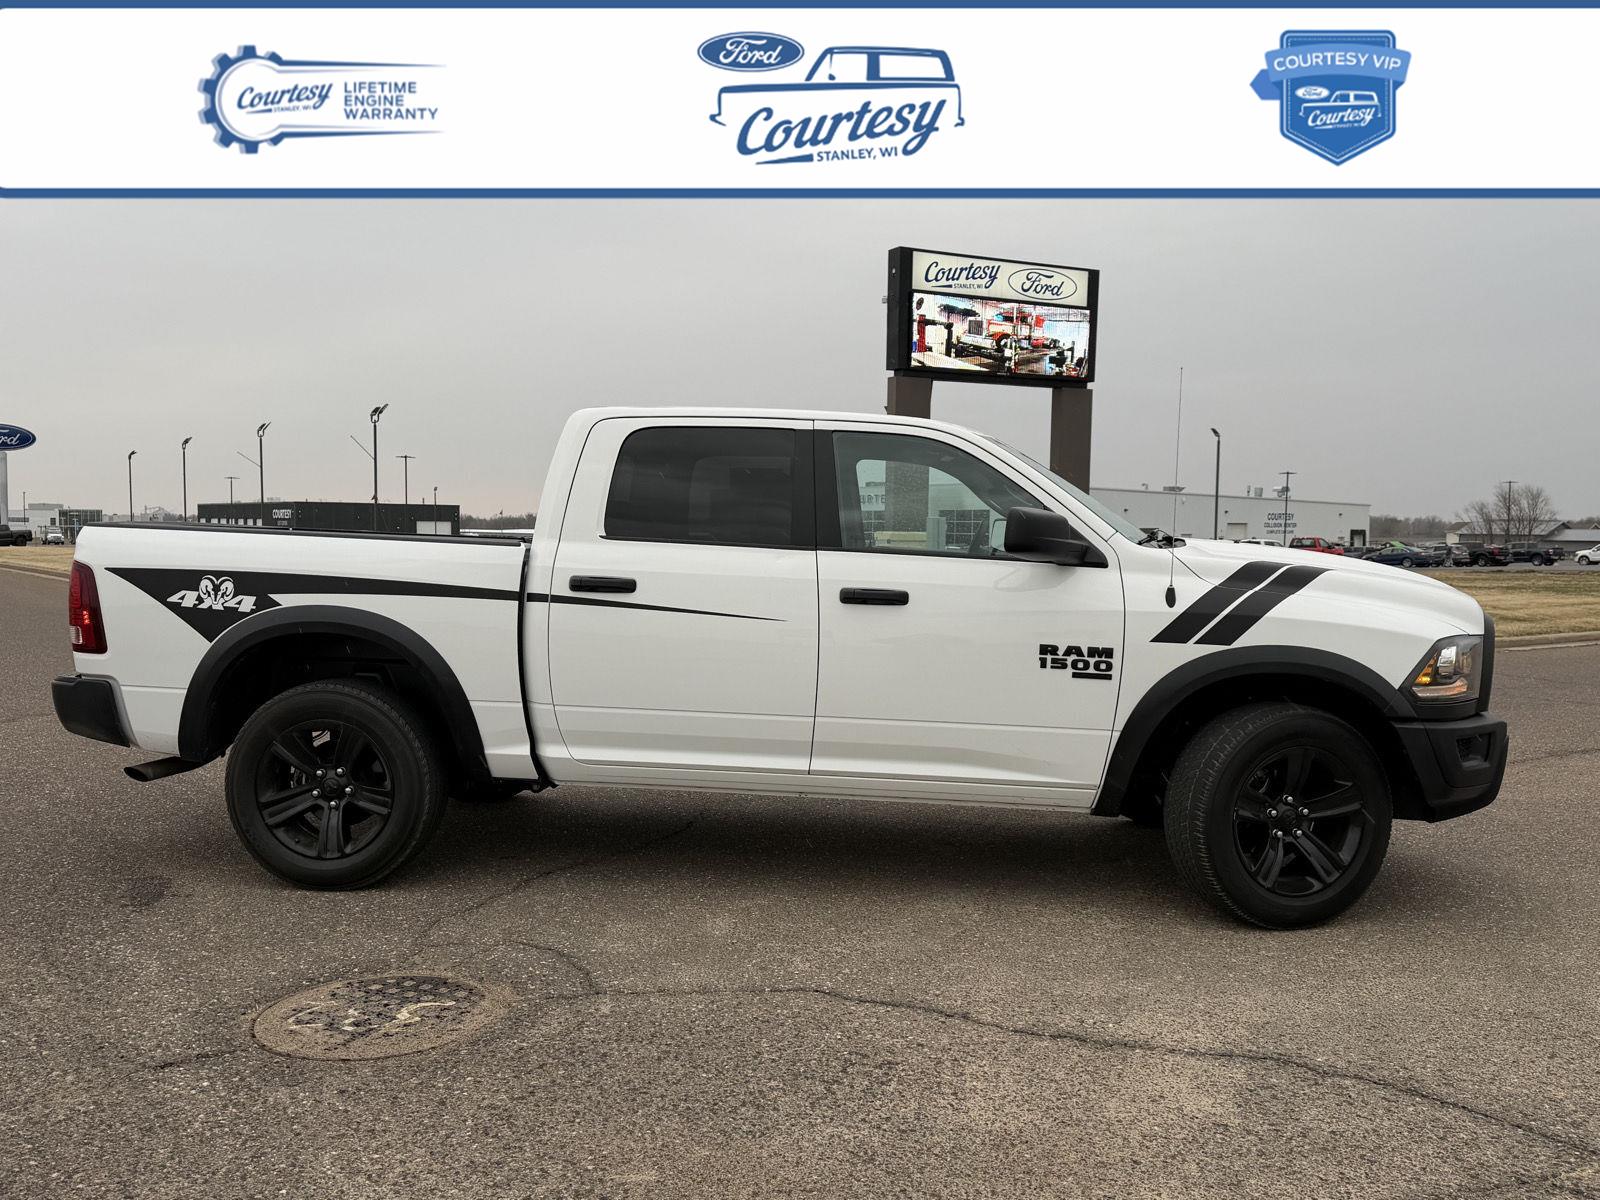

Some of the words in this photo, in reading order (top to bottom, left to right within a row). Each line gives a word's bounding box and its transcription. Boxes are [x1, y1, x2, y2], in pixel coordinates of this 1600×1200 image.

[924, 260, 1001, 289] Courtesy
[1021, 271, 1065, 296] Ford
[272, 509, 293, 519] COURTESY
[1039, 644, 1114, 659] RAM
[1039, 657, 1113, 672] 1500
